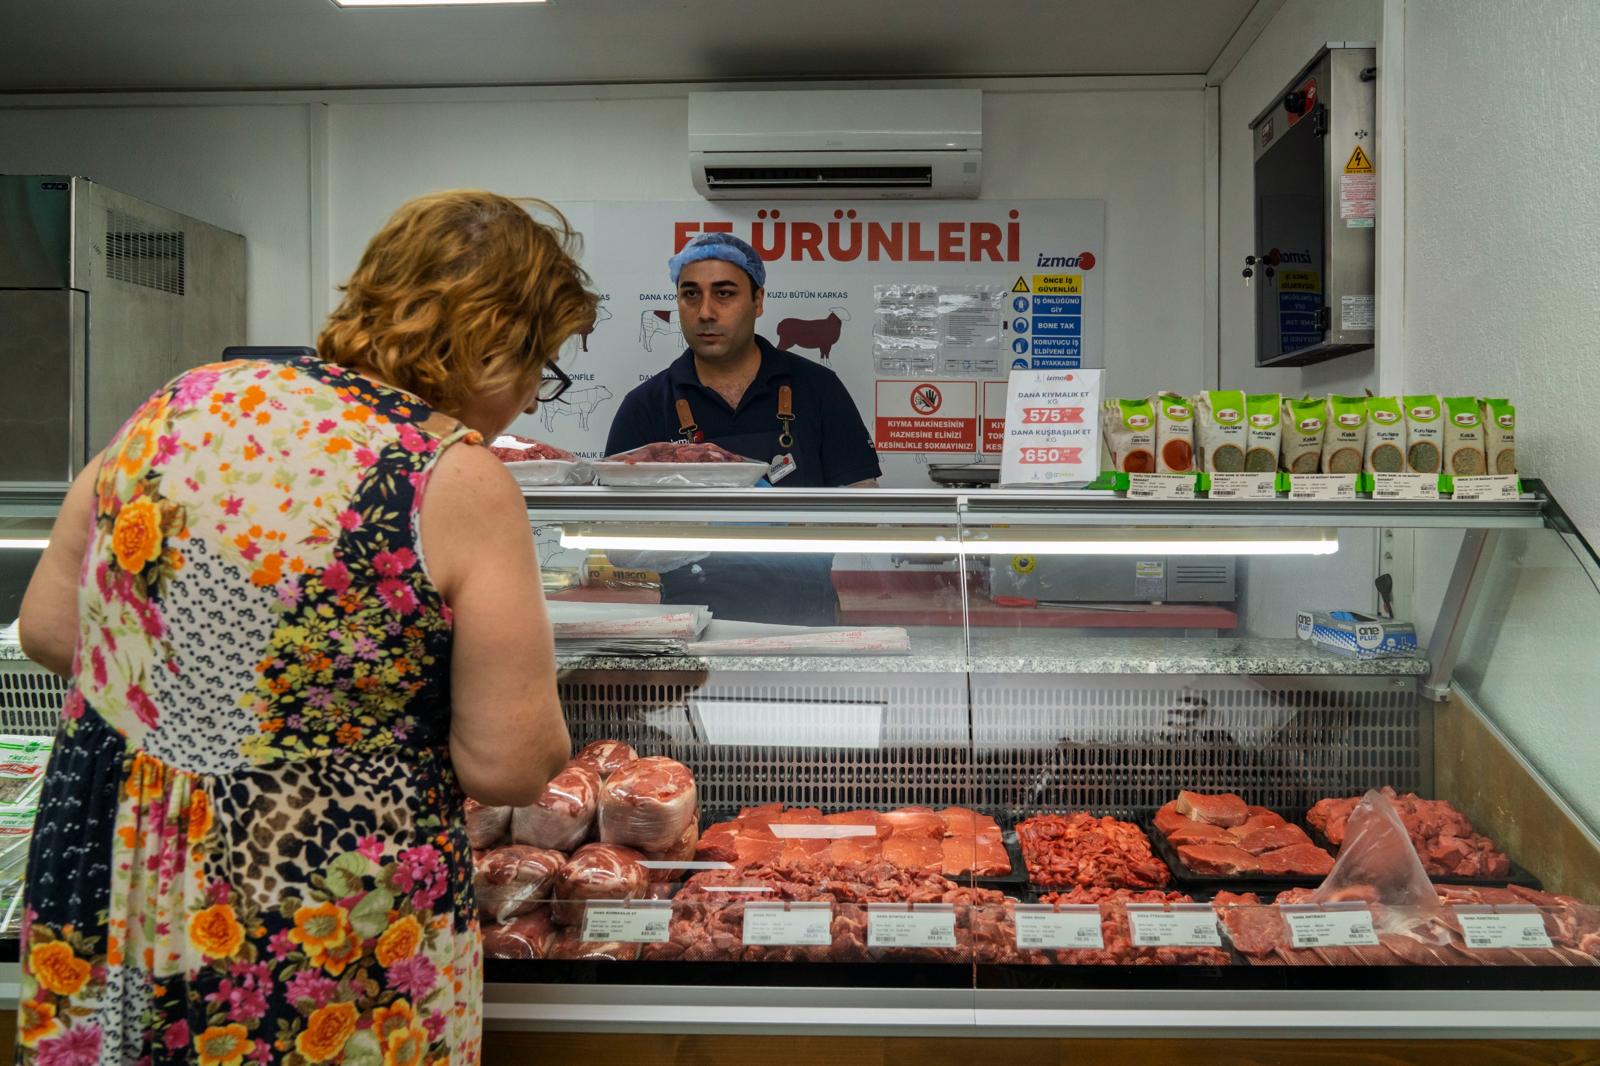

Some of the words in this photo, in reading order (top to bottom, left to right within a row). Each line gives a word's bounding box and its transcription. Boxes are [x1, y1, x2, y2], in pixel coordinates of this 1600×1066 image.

[751, 209, 1020, 262] ÜRÜNLERİ
[1037, 252, 1084, 268] izmar
[1043, 276, 1064, 284] ÖNCE
[1065, 276, 1073, 285] İŞ
[1038, 285, 1079, 293] GÜVENLİĞİ
[639, 293, 662, 301] DANA
[767, 291, 788, 299] KUZU
[789, 290, 816, 299] BÜTÜN
[817, 291, 849, 299] KARKAS
[568, 373, 595, 381] ONFİLE
[1029, 409, 1061, 422] 575
[887, 420, 912, 428] KIYMA
[913, 420, 965, 429] MAKİNESİNİN
[890, 430, 933, 439] HAZNESİNE
[934, 430, 962, 439] ELİNİZİ
[1035, 429, 1081, 437] KUŞBAŞILIK
[878, 441, 923, 449] KESİNLİKLE
[924, 442, 973, 450] SOKMAYINIZ!
[1025, 449, 1059, 462] 650
[1298, 614, 1312, 626] one
[1358, 626, 1380, 635] one
